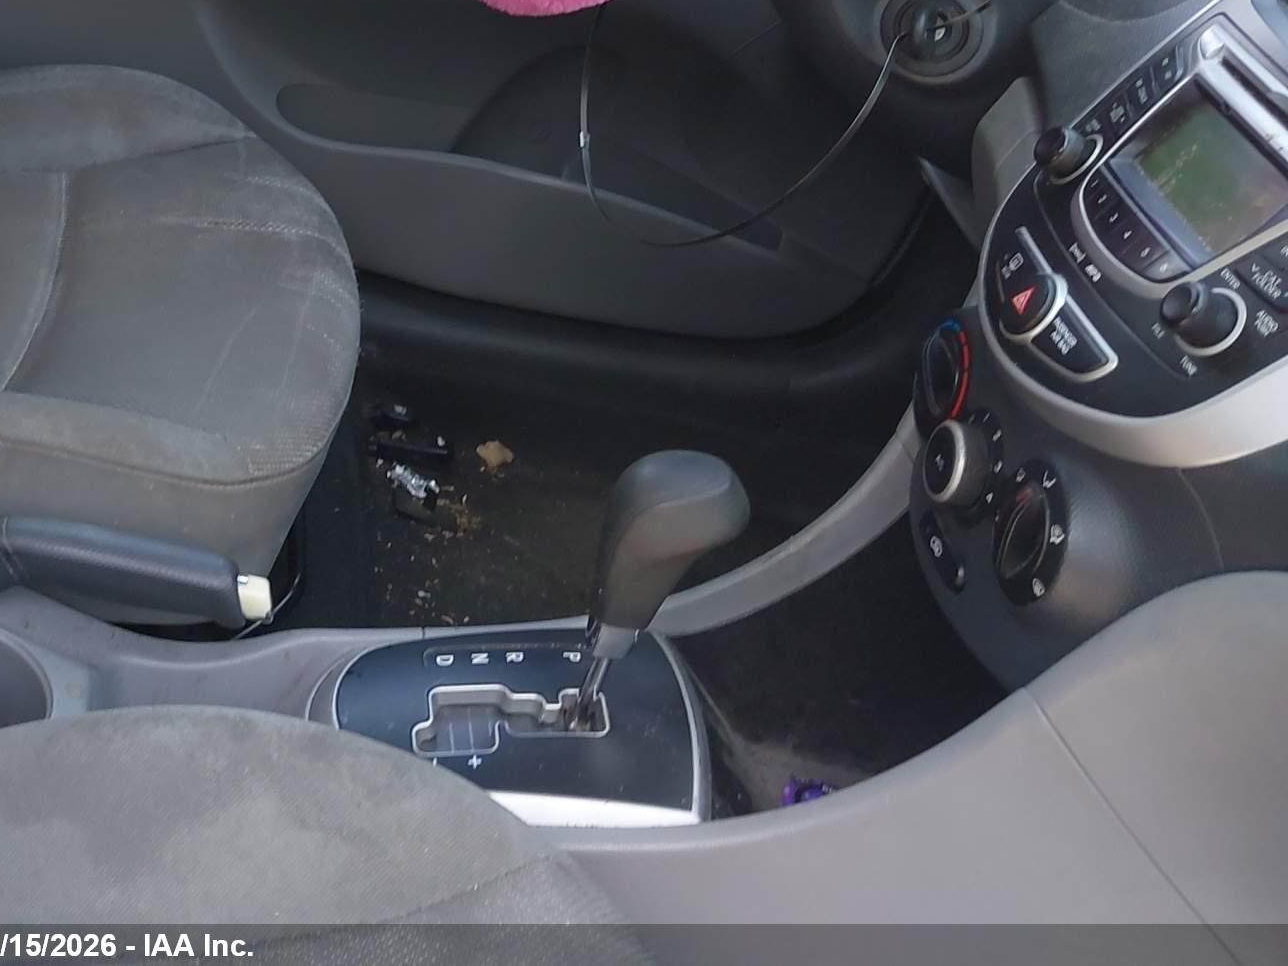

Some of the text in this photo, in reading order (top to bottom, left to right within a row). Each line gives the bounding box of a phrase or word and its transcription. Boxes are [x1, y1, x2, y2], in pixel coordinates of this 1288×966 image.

[1220, 267, 1241, 290] ENTER
[435, 654, 455, 667] D
[471, 652, 490, 665] N
[505, 651, 524, 663] R
[562, 651, 582, 663] P
